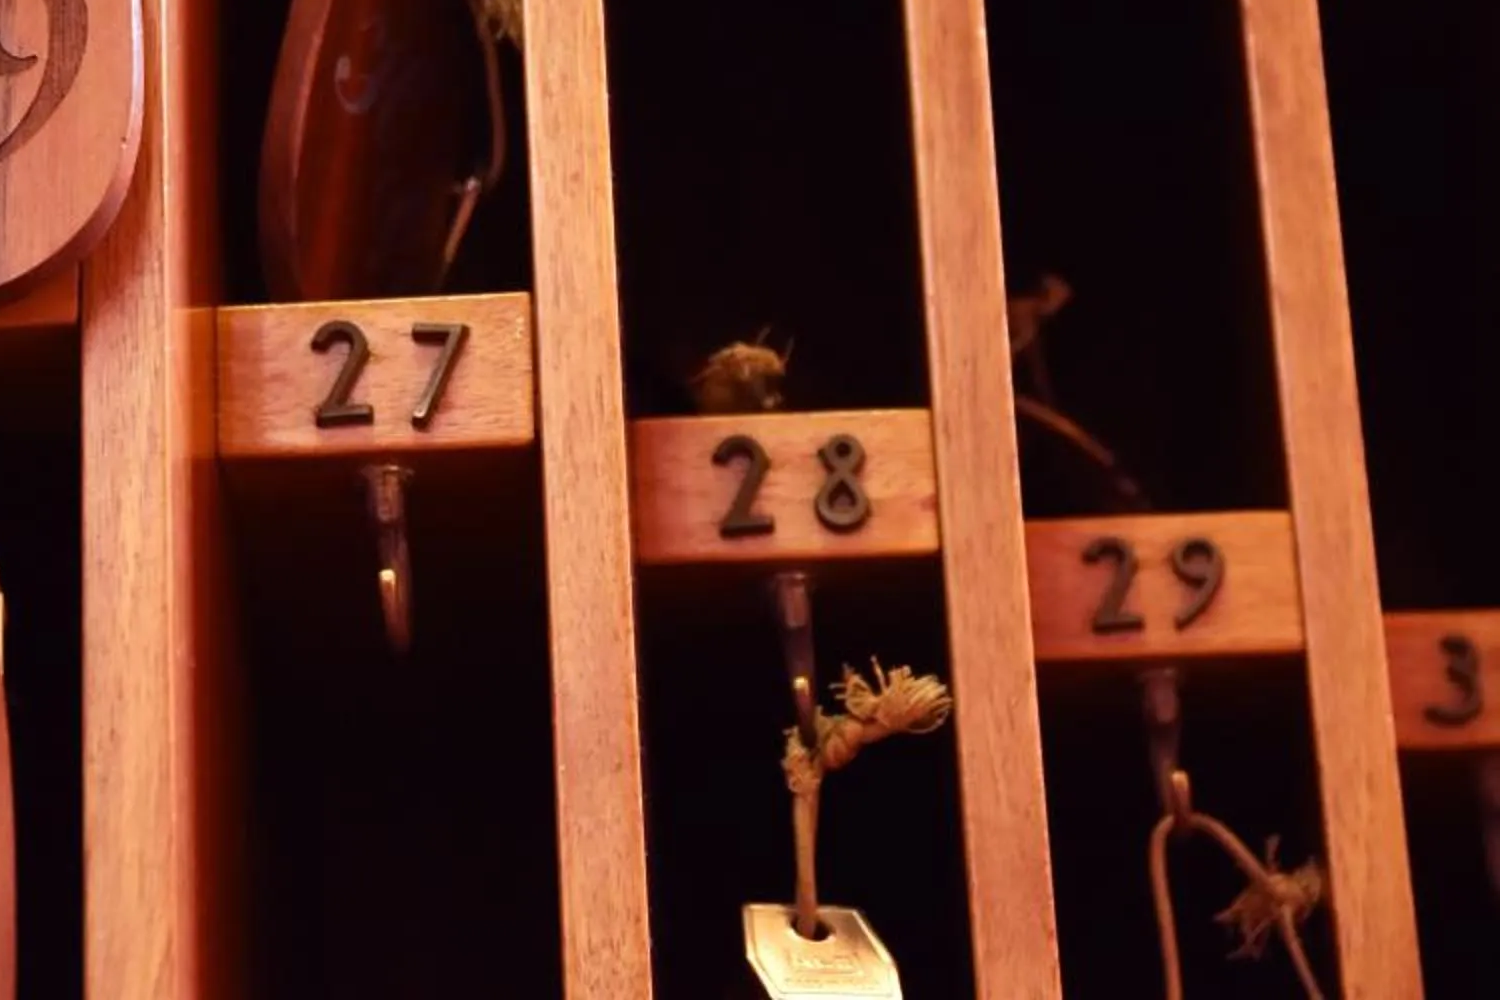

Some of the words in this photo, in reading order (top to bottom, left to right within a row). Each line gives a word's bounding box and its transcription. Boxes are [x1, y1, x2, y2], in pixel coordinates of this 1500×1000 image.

[309, 319, 471, 430] 27
[711, 433, 871, 540] 28
[1082, 536, 1225, 635] 29
